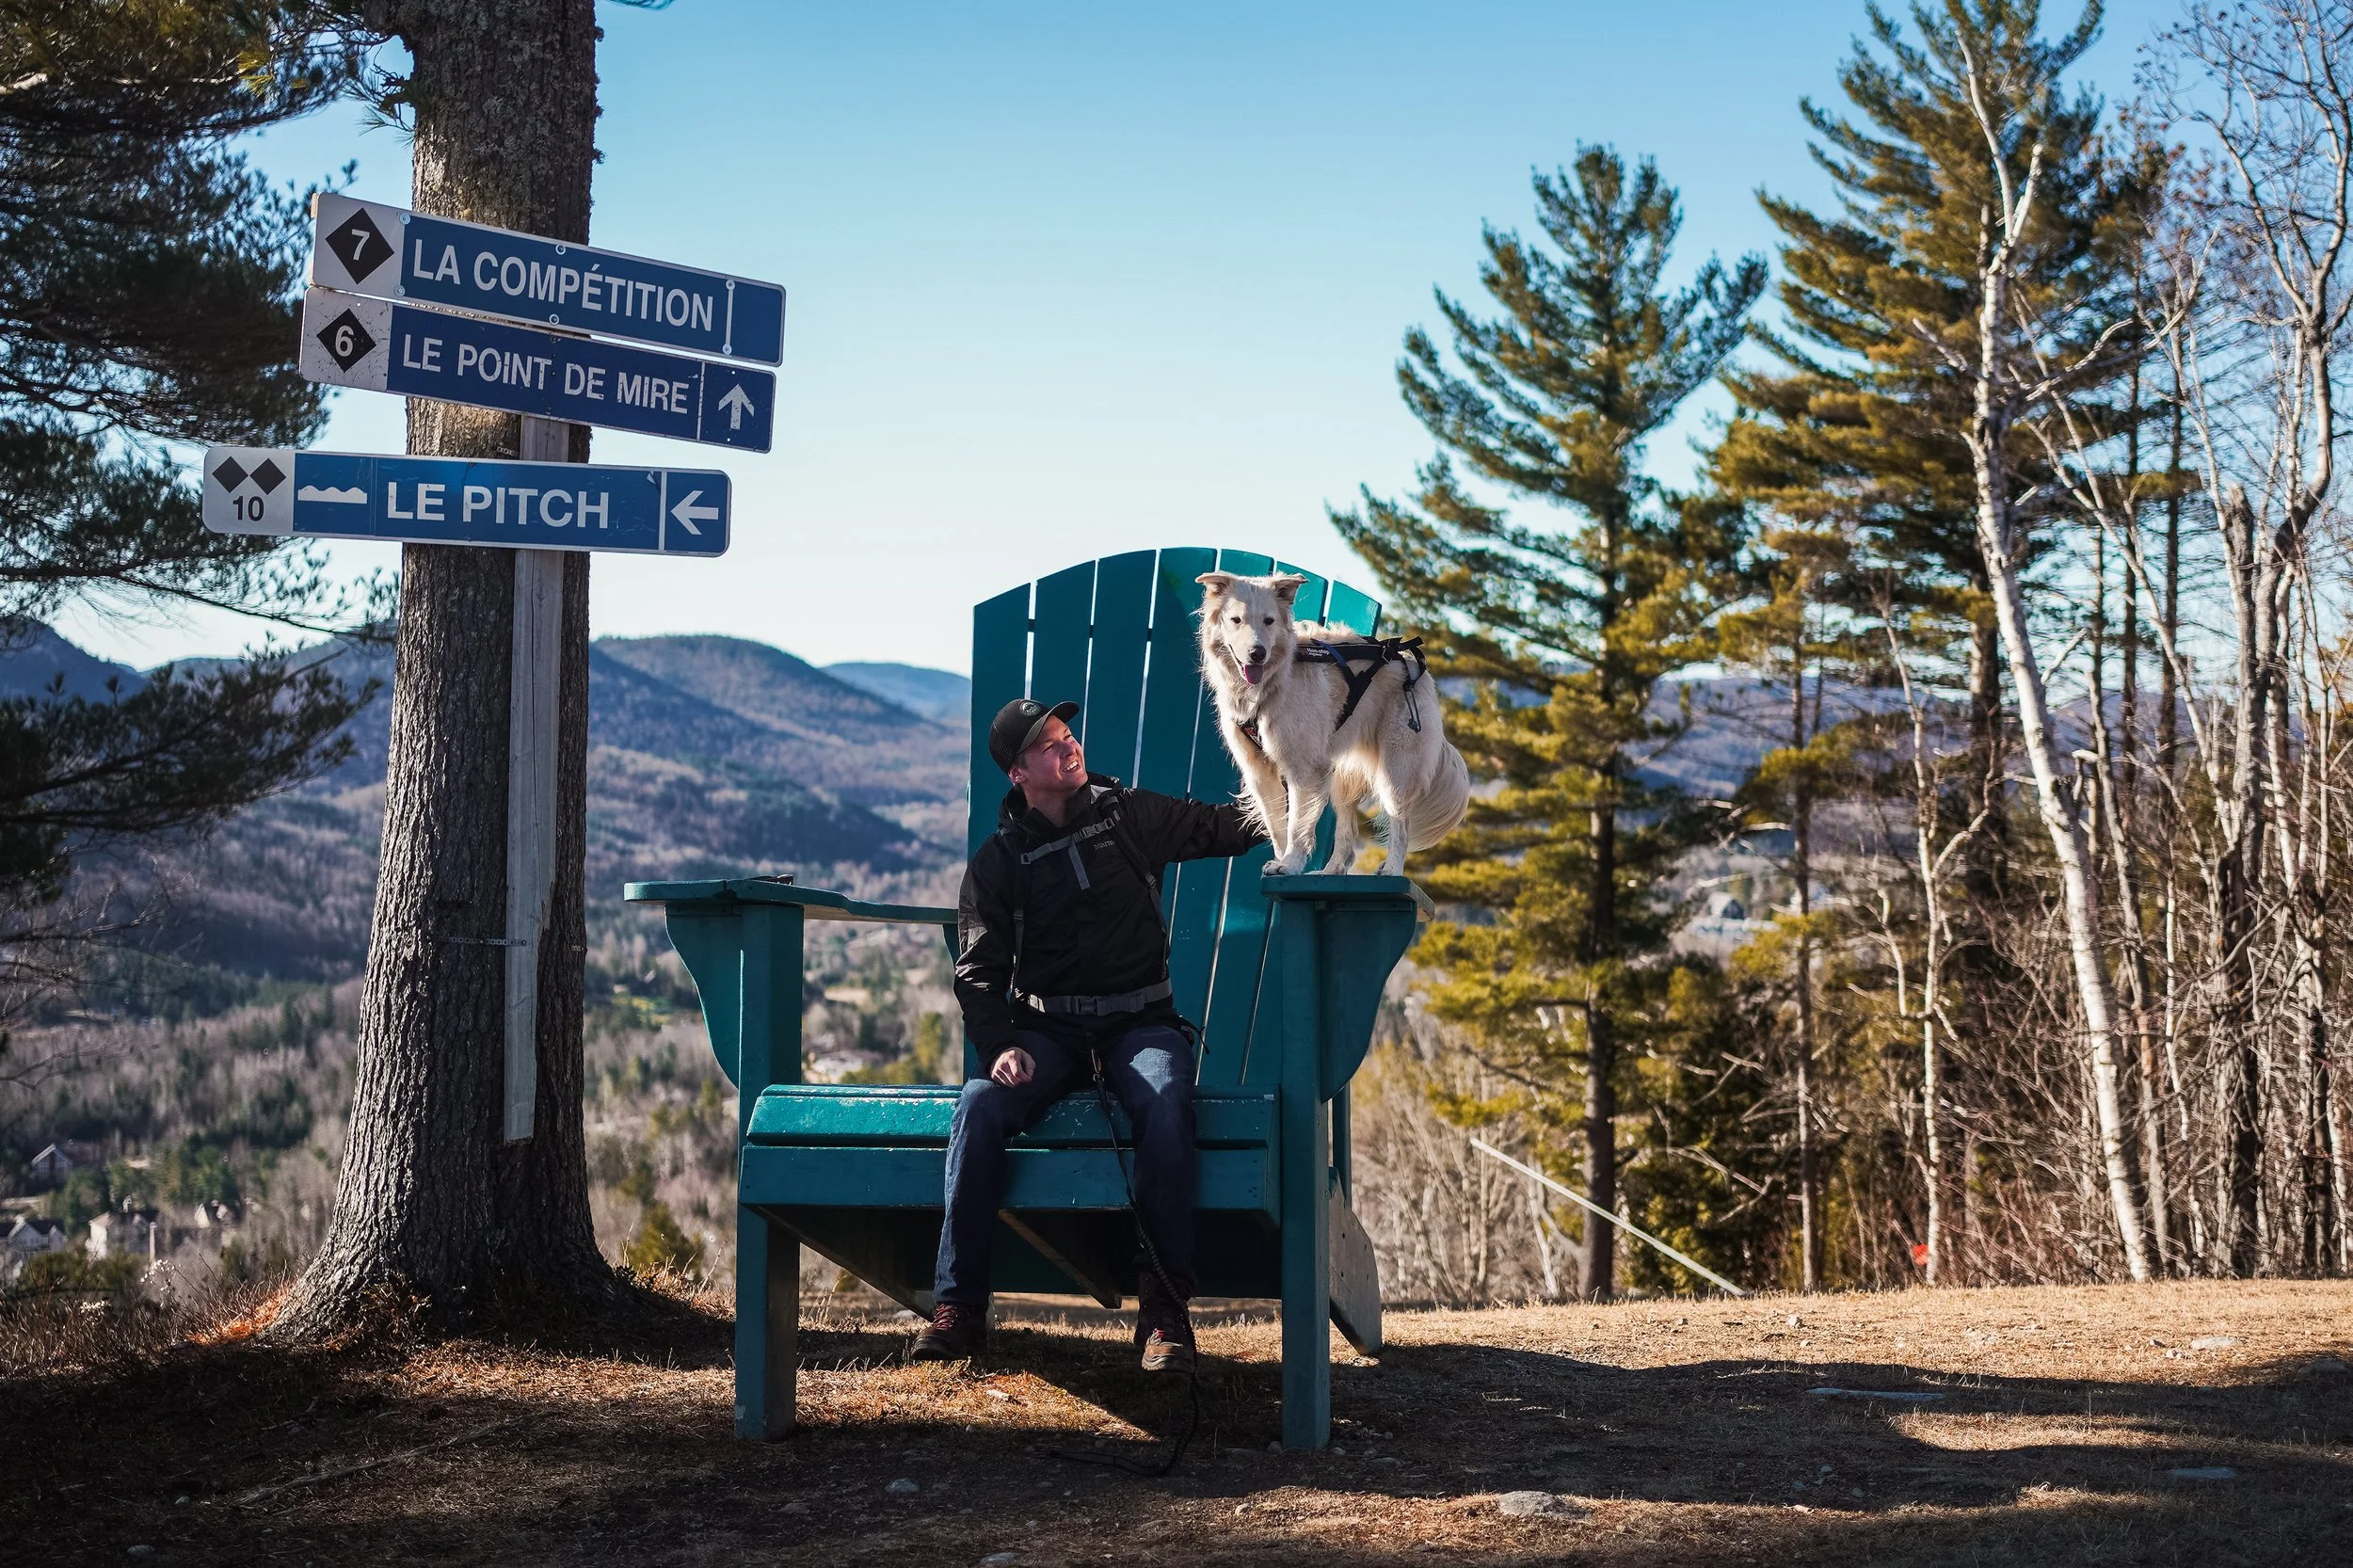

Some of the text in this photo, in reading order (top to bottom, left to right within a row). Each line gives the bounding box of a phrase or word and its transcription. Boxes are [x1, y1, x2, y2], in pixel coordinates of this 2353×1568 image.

[352, 230, 713, 331] 7 LA COMPÉTITION
[335, 325, 689, 414] 6 LE POINT DE MIRE
[232, 495, 264, 522] 10
[387, 481, 609, 529] LE PITCH
